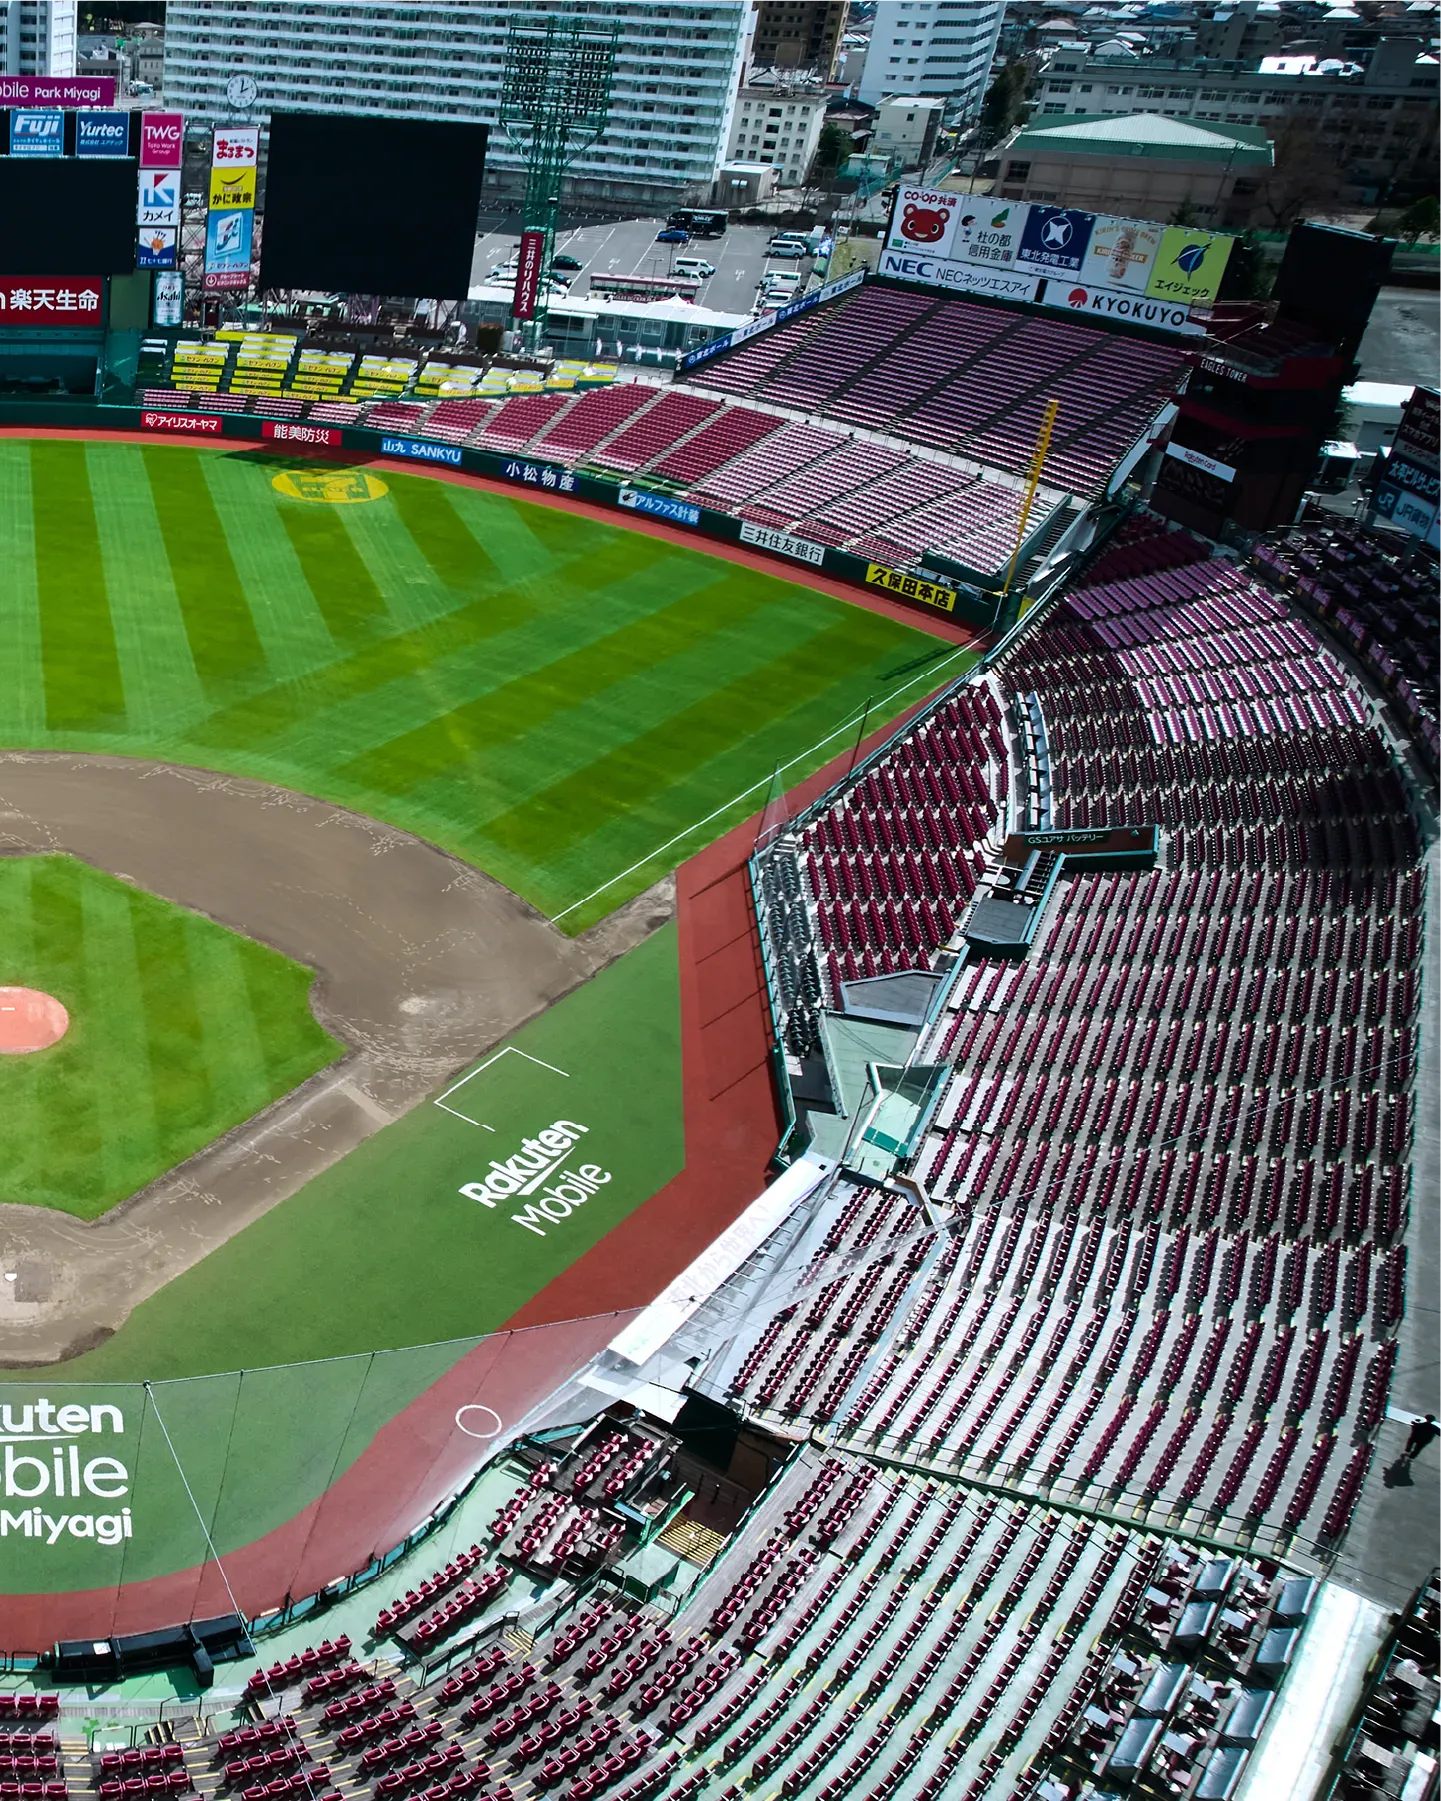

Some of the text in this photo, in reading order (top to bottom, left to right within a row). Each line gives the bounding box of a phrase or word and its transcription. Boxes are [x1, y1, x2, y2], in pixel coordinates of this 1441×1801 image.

[35, 87, 61, 99] Park
[63, 87, 101, 101] Miyagi
[14, 115, 60, 136] Fuji
[80, 121, 124, 137] Yurtec
[145, 125, 180, 140] TWG
[216, 139, 255, 159] まるまつ
[212, 192, 252, 205] かに政宗
[143, 211, 174, 222] カメイ
[977, 231, 1012, 247] 杜の都
[968, 245, 1013, 262] 信用金庫
[1021, 247, 1081, 270] 東北発電工業
[519, 238, 537, 313] 三井のリハウス
[886, 257, 1031, 296] NEC NECネッツエスアイ
[157, 292, 181, 302] Asahi
[1155, 279, 1210, 298] エイジェック
[10, 288, 100, 312] 楽天生命
[1092, 295, 1185, 327] KYOKUYO
[1200, 358, 1248, 384] EAGLES TOWER
[158, 415, 218, 431] アイリスオーヤマ
[273, 425, 330, 445] 能美防災
[383, 440, 461, 462] 山九 SANKYU
[506, 462, 575, 492] 小松物産
[636, 494, 699, 523] アルファス計装
[742, 525, 823, 563] 三井住友銀行
[872, 567, 952, 609] 久保田本店
[1028, 833, 1104, 844] GSユアサ バッテリー
[458, 1120, 590, 1209] Rakuten
[511, 1164, 612, 1237] Mobile
[0, 1507, 132, 1544] Miyagi
